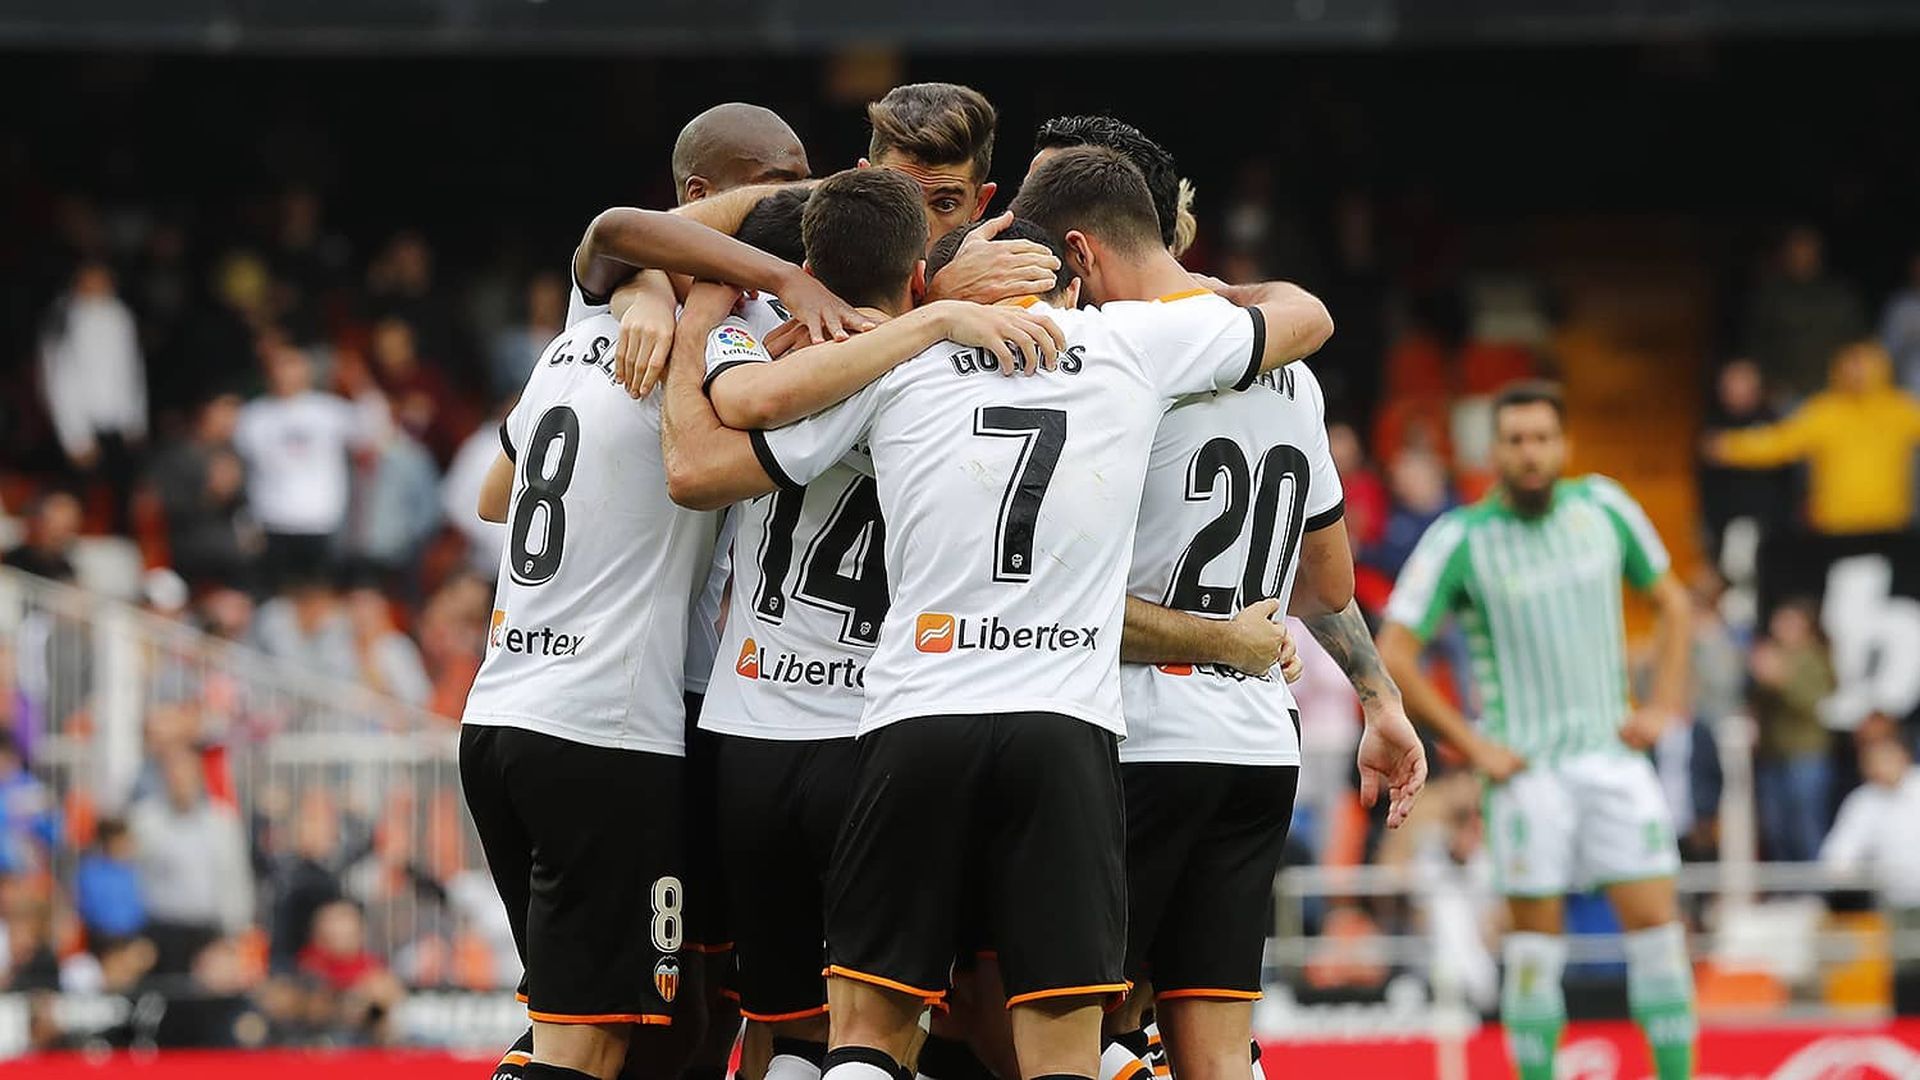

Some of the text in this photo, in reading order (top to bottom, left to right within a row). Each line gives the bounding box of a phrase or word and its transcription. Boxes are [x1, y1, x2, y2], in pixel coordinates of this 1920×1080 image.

[510, 405, 580, 586] 8
[973, 405, 1067, 583] 7
[1166, 437, 1310, 620] 20
[752, 475, 891, 648] 14
[504, 624, 585, 656] ertex
[759, 647, 866, 688] Libert
[957, 616, 1099, 651] Libertex
[651, 876, 683, 953] 8
